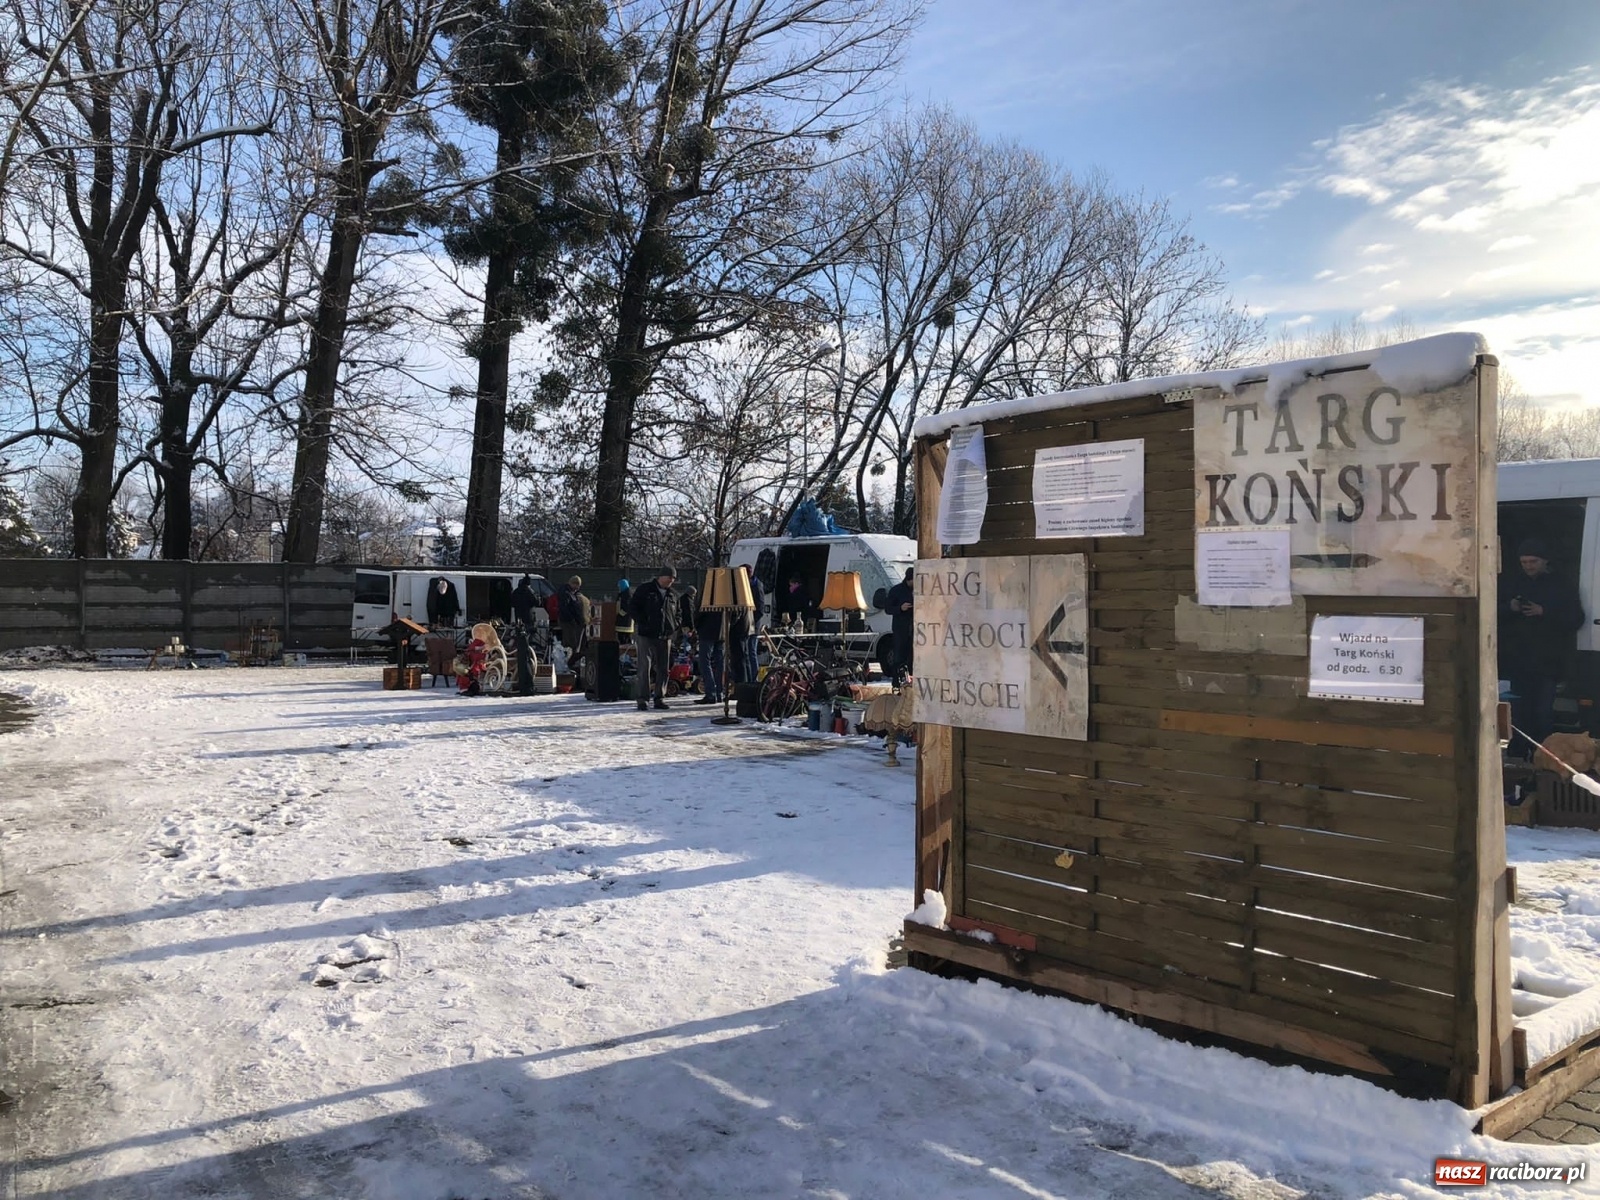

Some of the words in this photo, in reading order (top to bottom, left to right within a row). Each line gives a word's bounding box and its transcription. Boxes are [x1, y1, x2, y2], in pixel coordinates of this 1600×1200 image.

[1223, 386, 1406, 456] TARG
[1205, 459, 1452, 526] KOŃSKI
[916, 571, 982, 597] TARG
[916, 622, 1028, 649] STAROCI
[1339, 633, 1372, 645] Wjazd
[1375, 635, 1388, 644] na
[1333, 648, 1357, 660] Targ
[1359, 649, 1395, 659] Koński
[1327, 662, 1340, 672] od
[1342, 664, 1370, 674] godz.
[1379, 665, 1403, 676] 6.30
[916, 674, 1020, 709] WEJŚCIE
